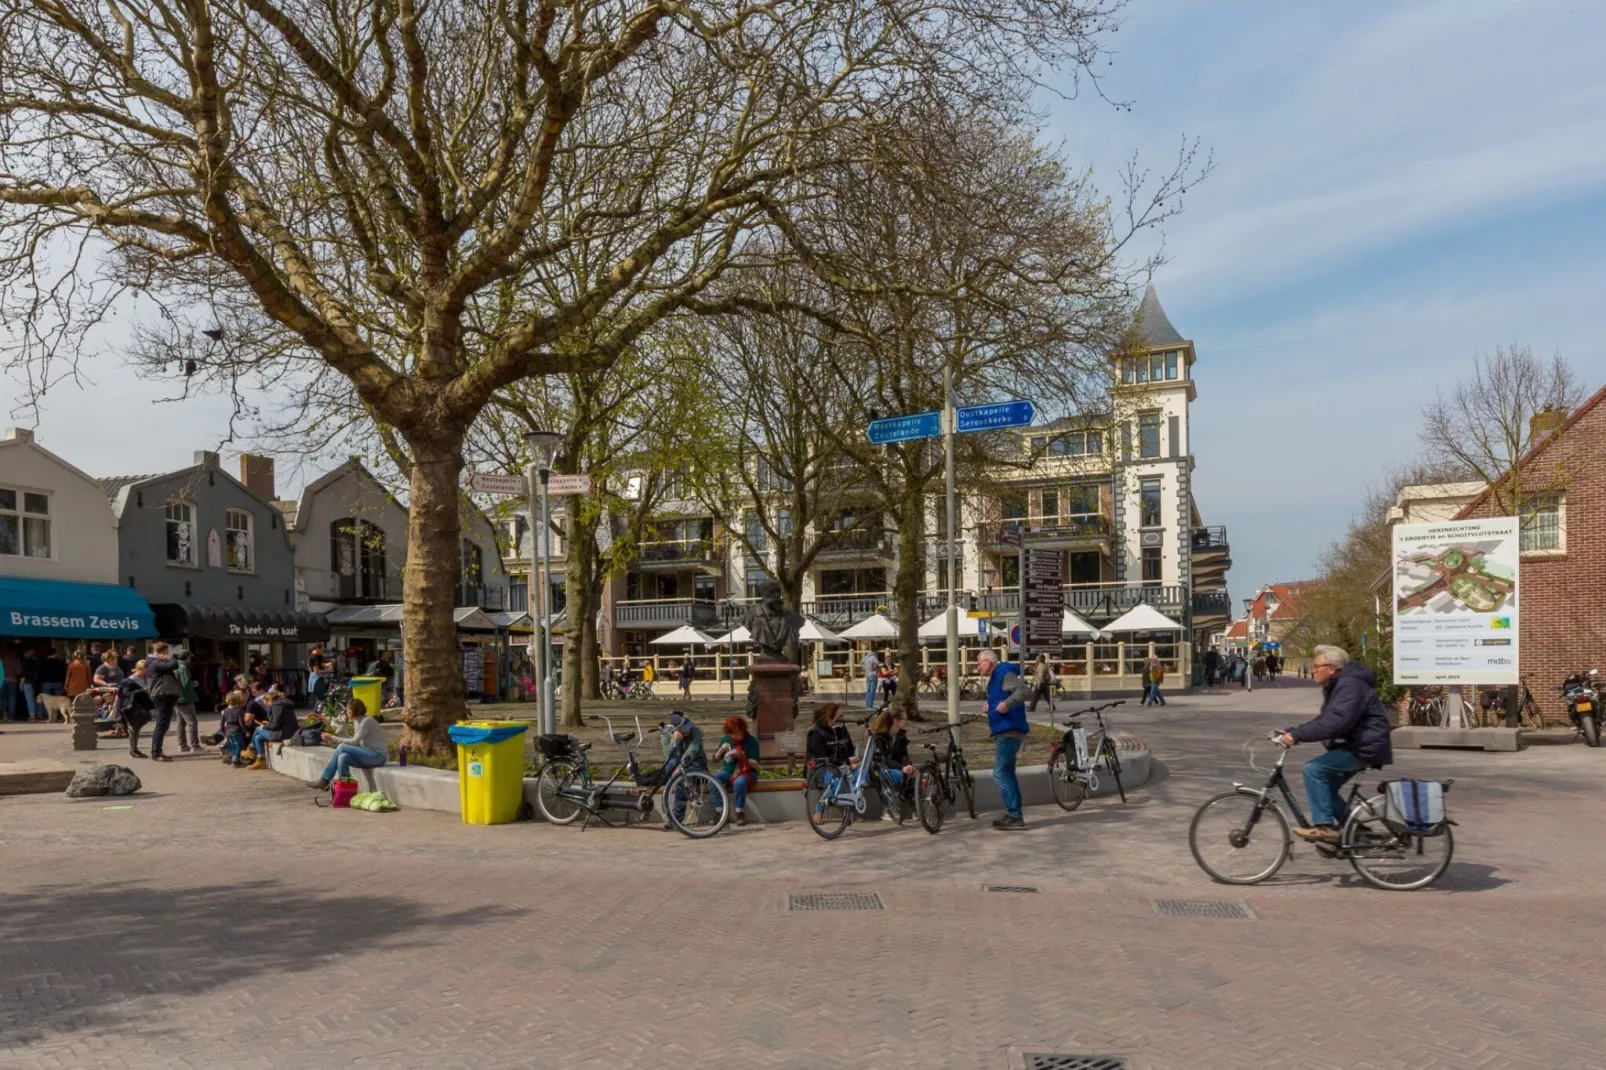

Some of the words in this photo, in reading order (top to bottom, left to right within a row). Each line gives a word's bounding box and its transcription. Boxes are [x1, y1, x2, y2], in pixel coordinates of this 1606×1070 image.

[960, 406, 1009, 417] Oostkapelle
[874, 419, 921, 430] Westkapelle
[960, 415, 1011, 427] Serooskerke
[874, 428, 919, 440] Zoutelande
[1405, 534, 1437, 542] GROENTJE
[1447, 529, 1513, 539] SCHUITVLOTSTRAAT
[1428, 525, 1481, 534] HERINRICHTING
[10, 612, 85, 628] Brassem
[89, 615, 139, 630] Zeevis
[229, 624, 240, 635] De
[244, 624, 262, 635] keet
[265, 626, 279, 636] van
[281, 626, 299, 636] kaat
